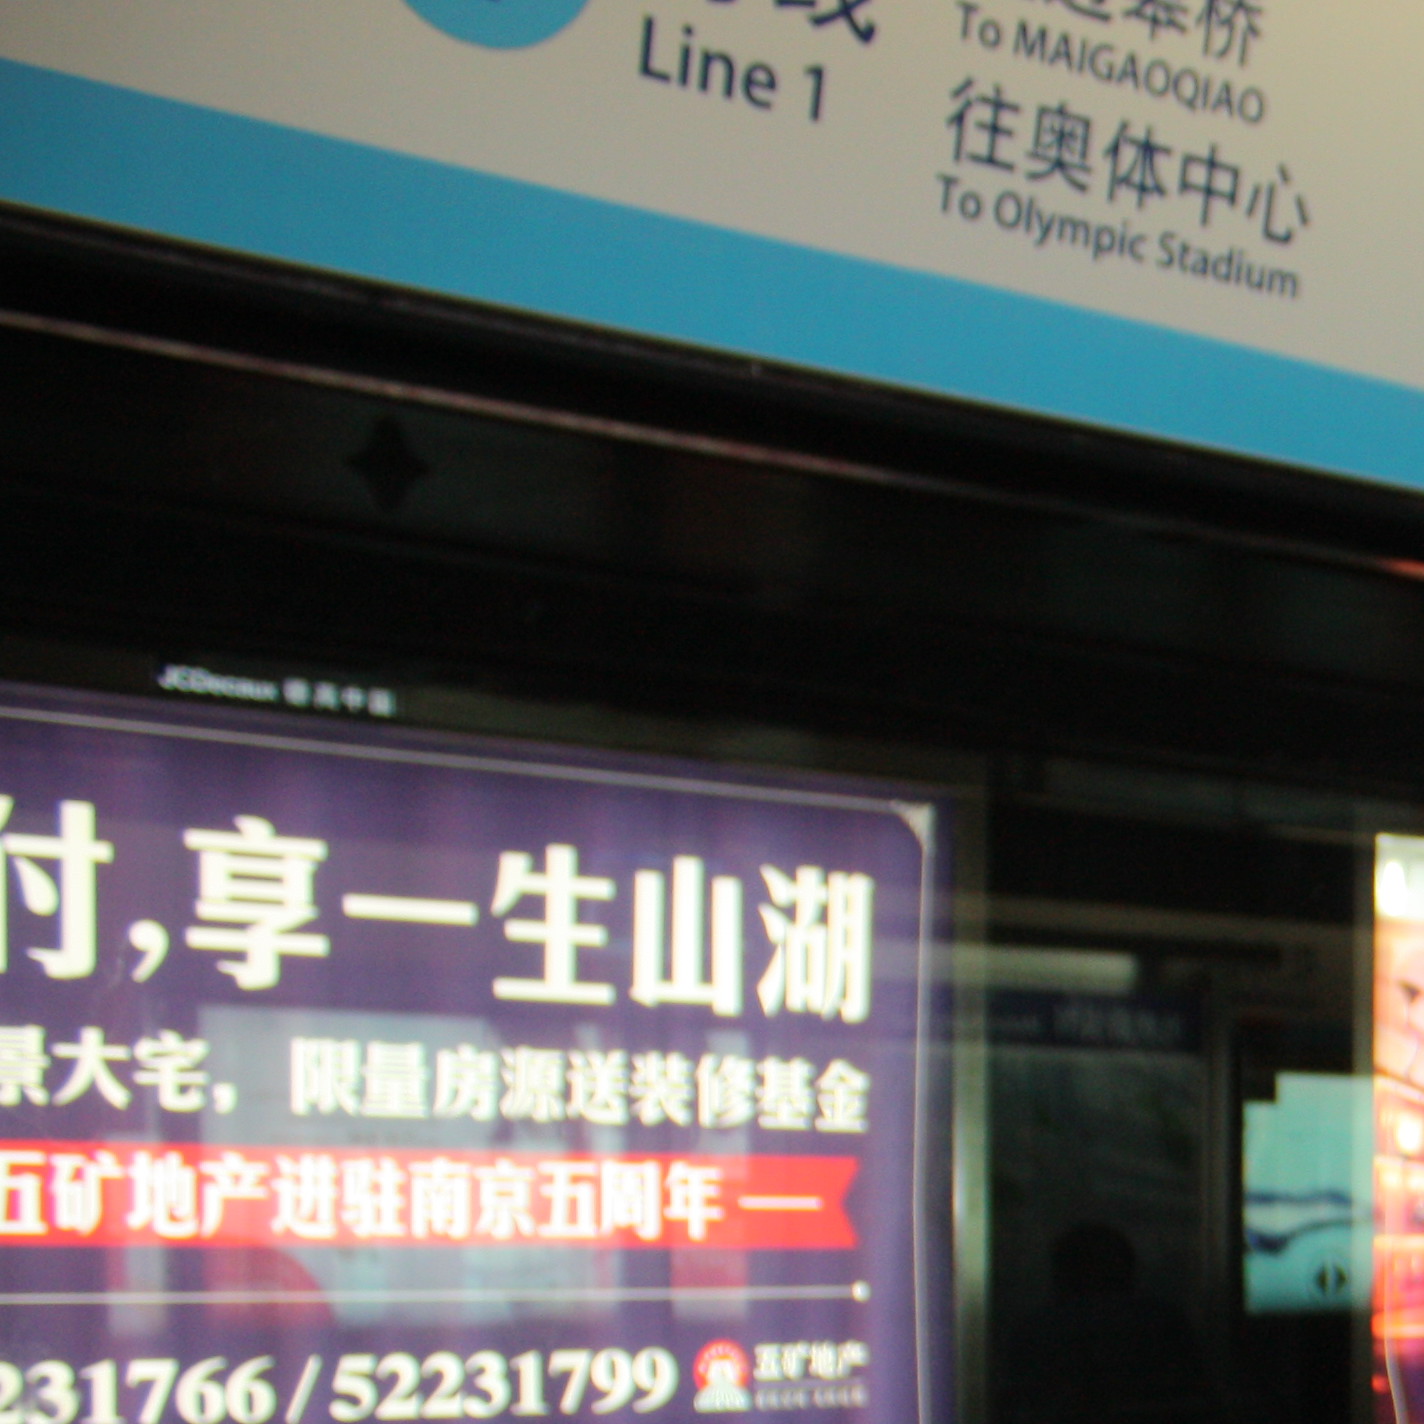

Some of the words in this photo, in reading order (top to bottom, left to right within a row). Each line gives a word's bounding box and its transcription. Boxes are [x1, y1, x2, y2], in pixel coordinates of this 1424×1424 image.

[638, 17, 778, 109] Line
[801, 65, 826, 122] 1
[956, 2, 1001, 49] To
[1013, 19, 1266, 126] MAIGAOQIAO
[946, 77, 1311, 245] 往奥体中心
[937, 174, 981, 221] To
[994, 190, 1145, 260] Olympic
[1158, 231, 1299, 299] Stadium
